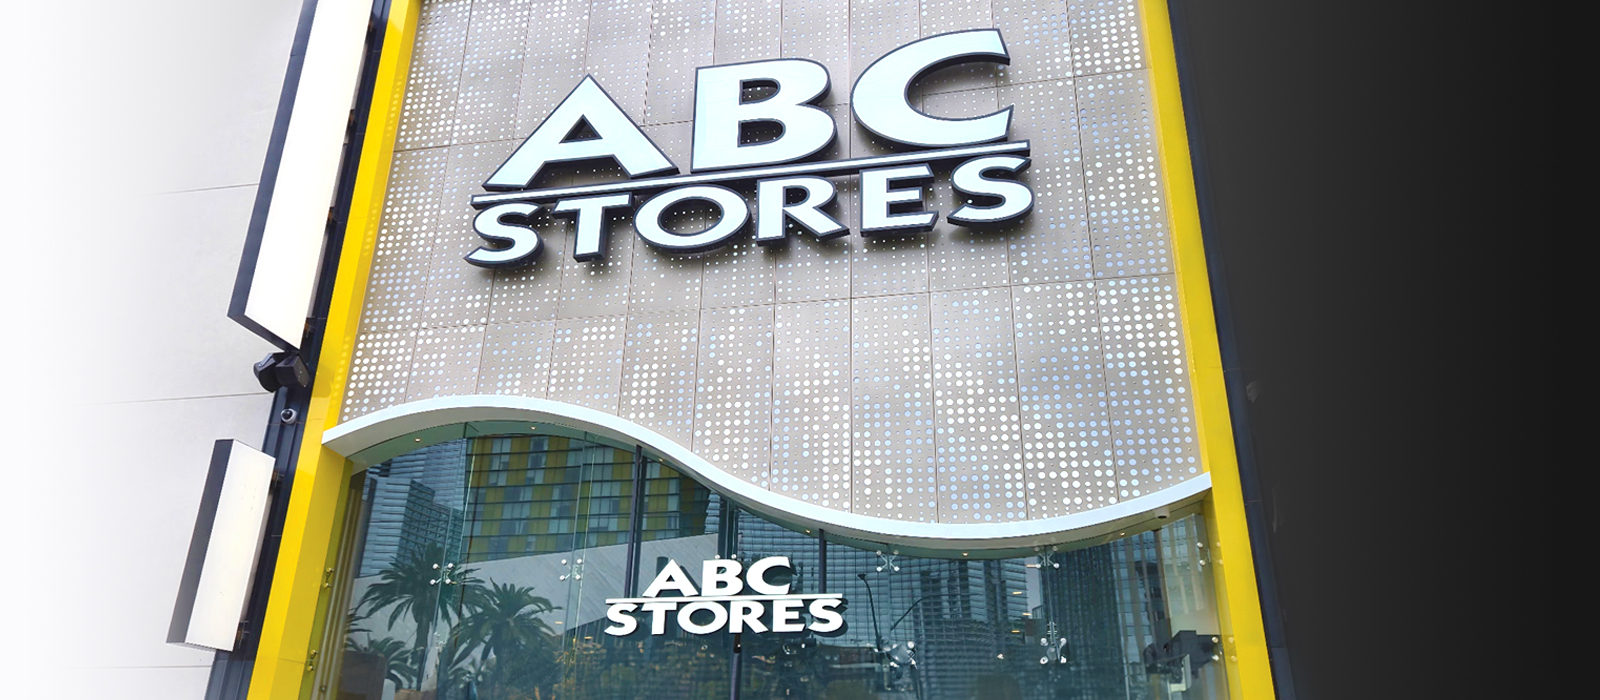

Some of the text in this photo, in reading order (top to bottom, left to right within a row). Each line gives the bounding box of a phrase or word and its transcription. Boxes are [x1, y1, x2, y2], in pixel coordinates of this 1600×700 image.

[482, 28, 1014, 190] ABC
[464, 154, 1034, 267] STORES
[642, 556, 791, 597] ABC
[604, 598, 844, 636] STORES
